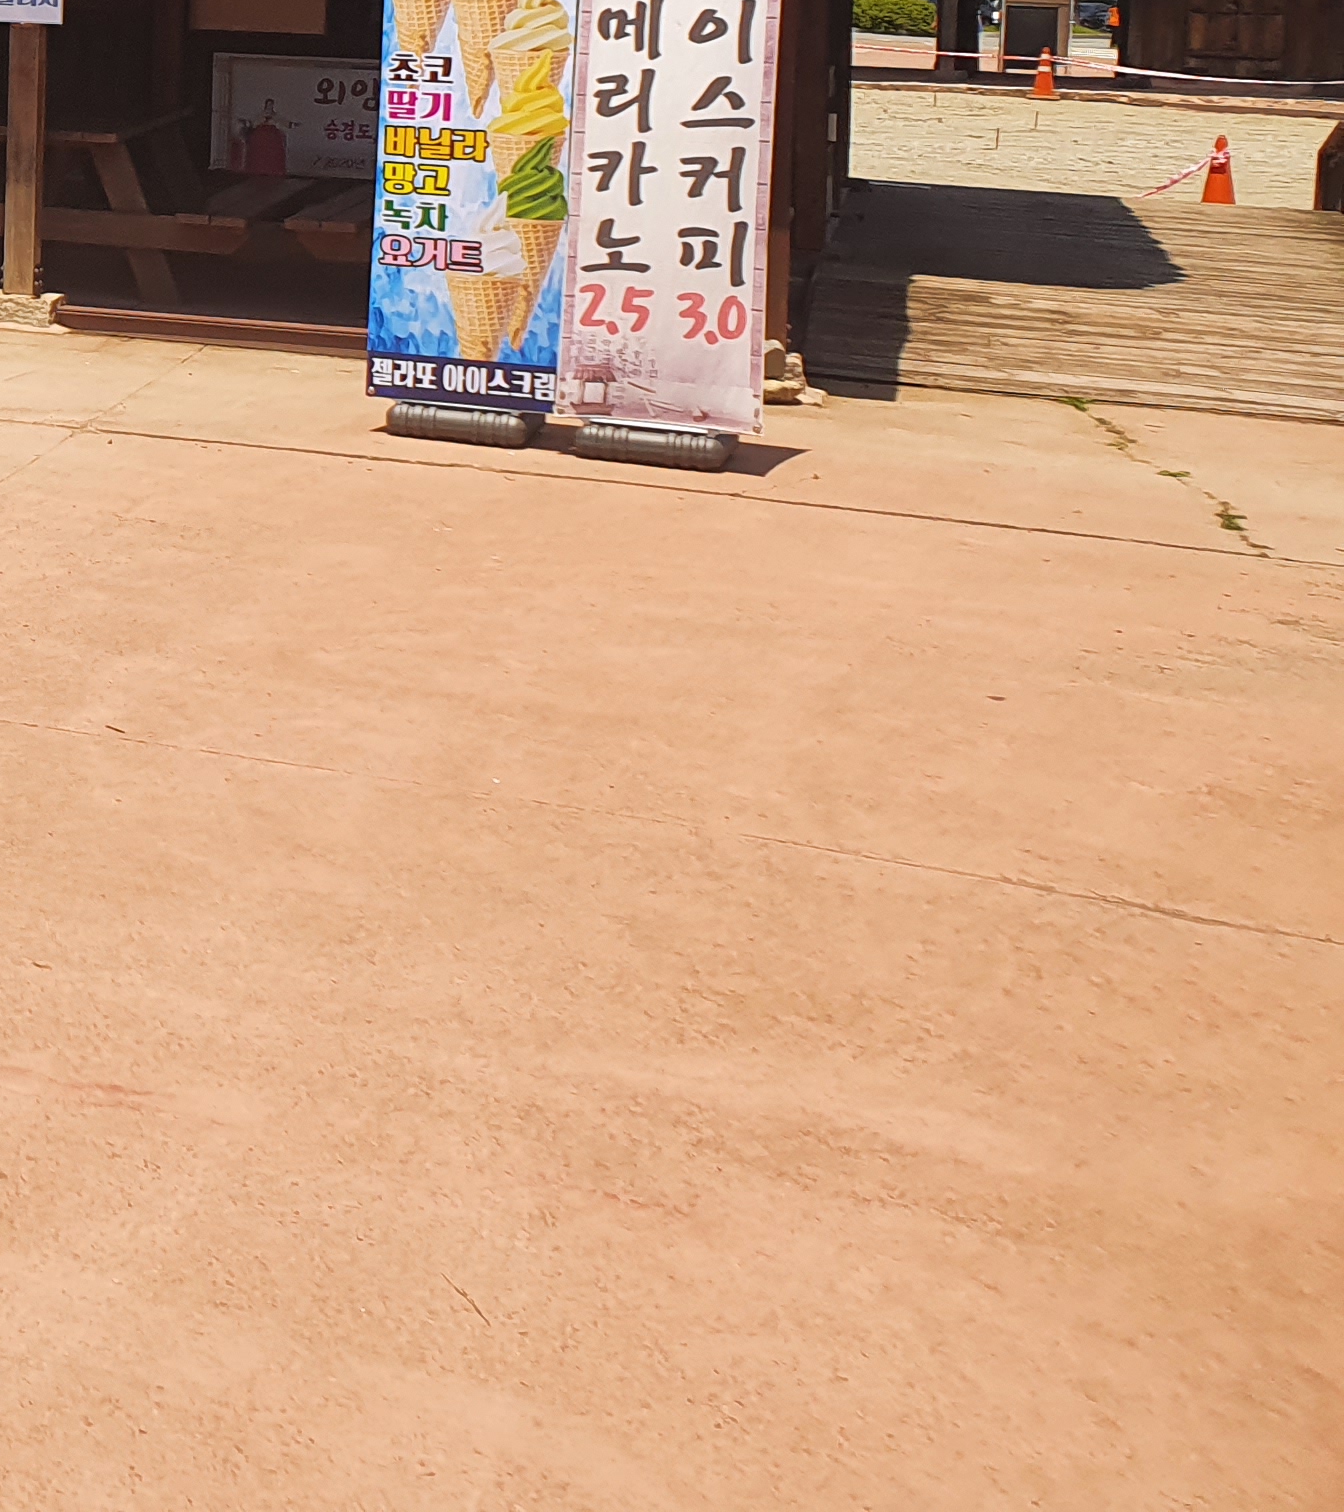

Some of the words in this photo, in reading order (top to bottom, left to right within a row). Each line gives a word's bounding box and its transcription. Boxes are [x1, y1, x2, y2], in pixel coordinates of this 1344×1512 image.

[388, 53, 454, 84] 쵸코
[388, 90, 453, 122] 딸기
[384, 125, 490, 163] 바닐라
[383, 161, 451, 196] 망고
[382, 199, 449, 232] 녹차
[378, 234, 484, 273] 요거트
[579, 284, 655, 335] 2.5
[677, 292, 747, 345] 3.0
[371, 357, 438, 390] 젤라또
[442, 363, 556, 401] 아이스크림
